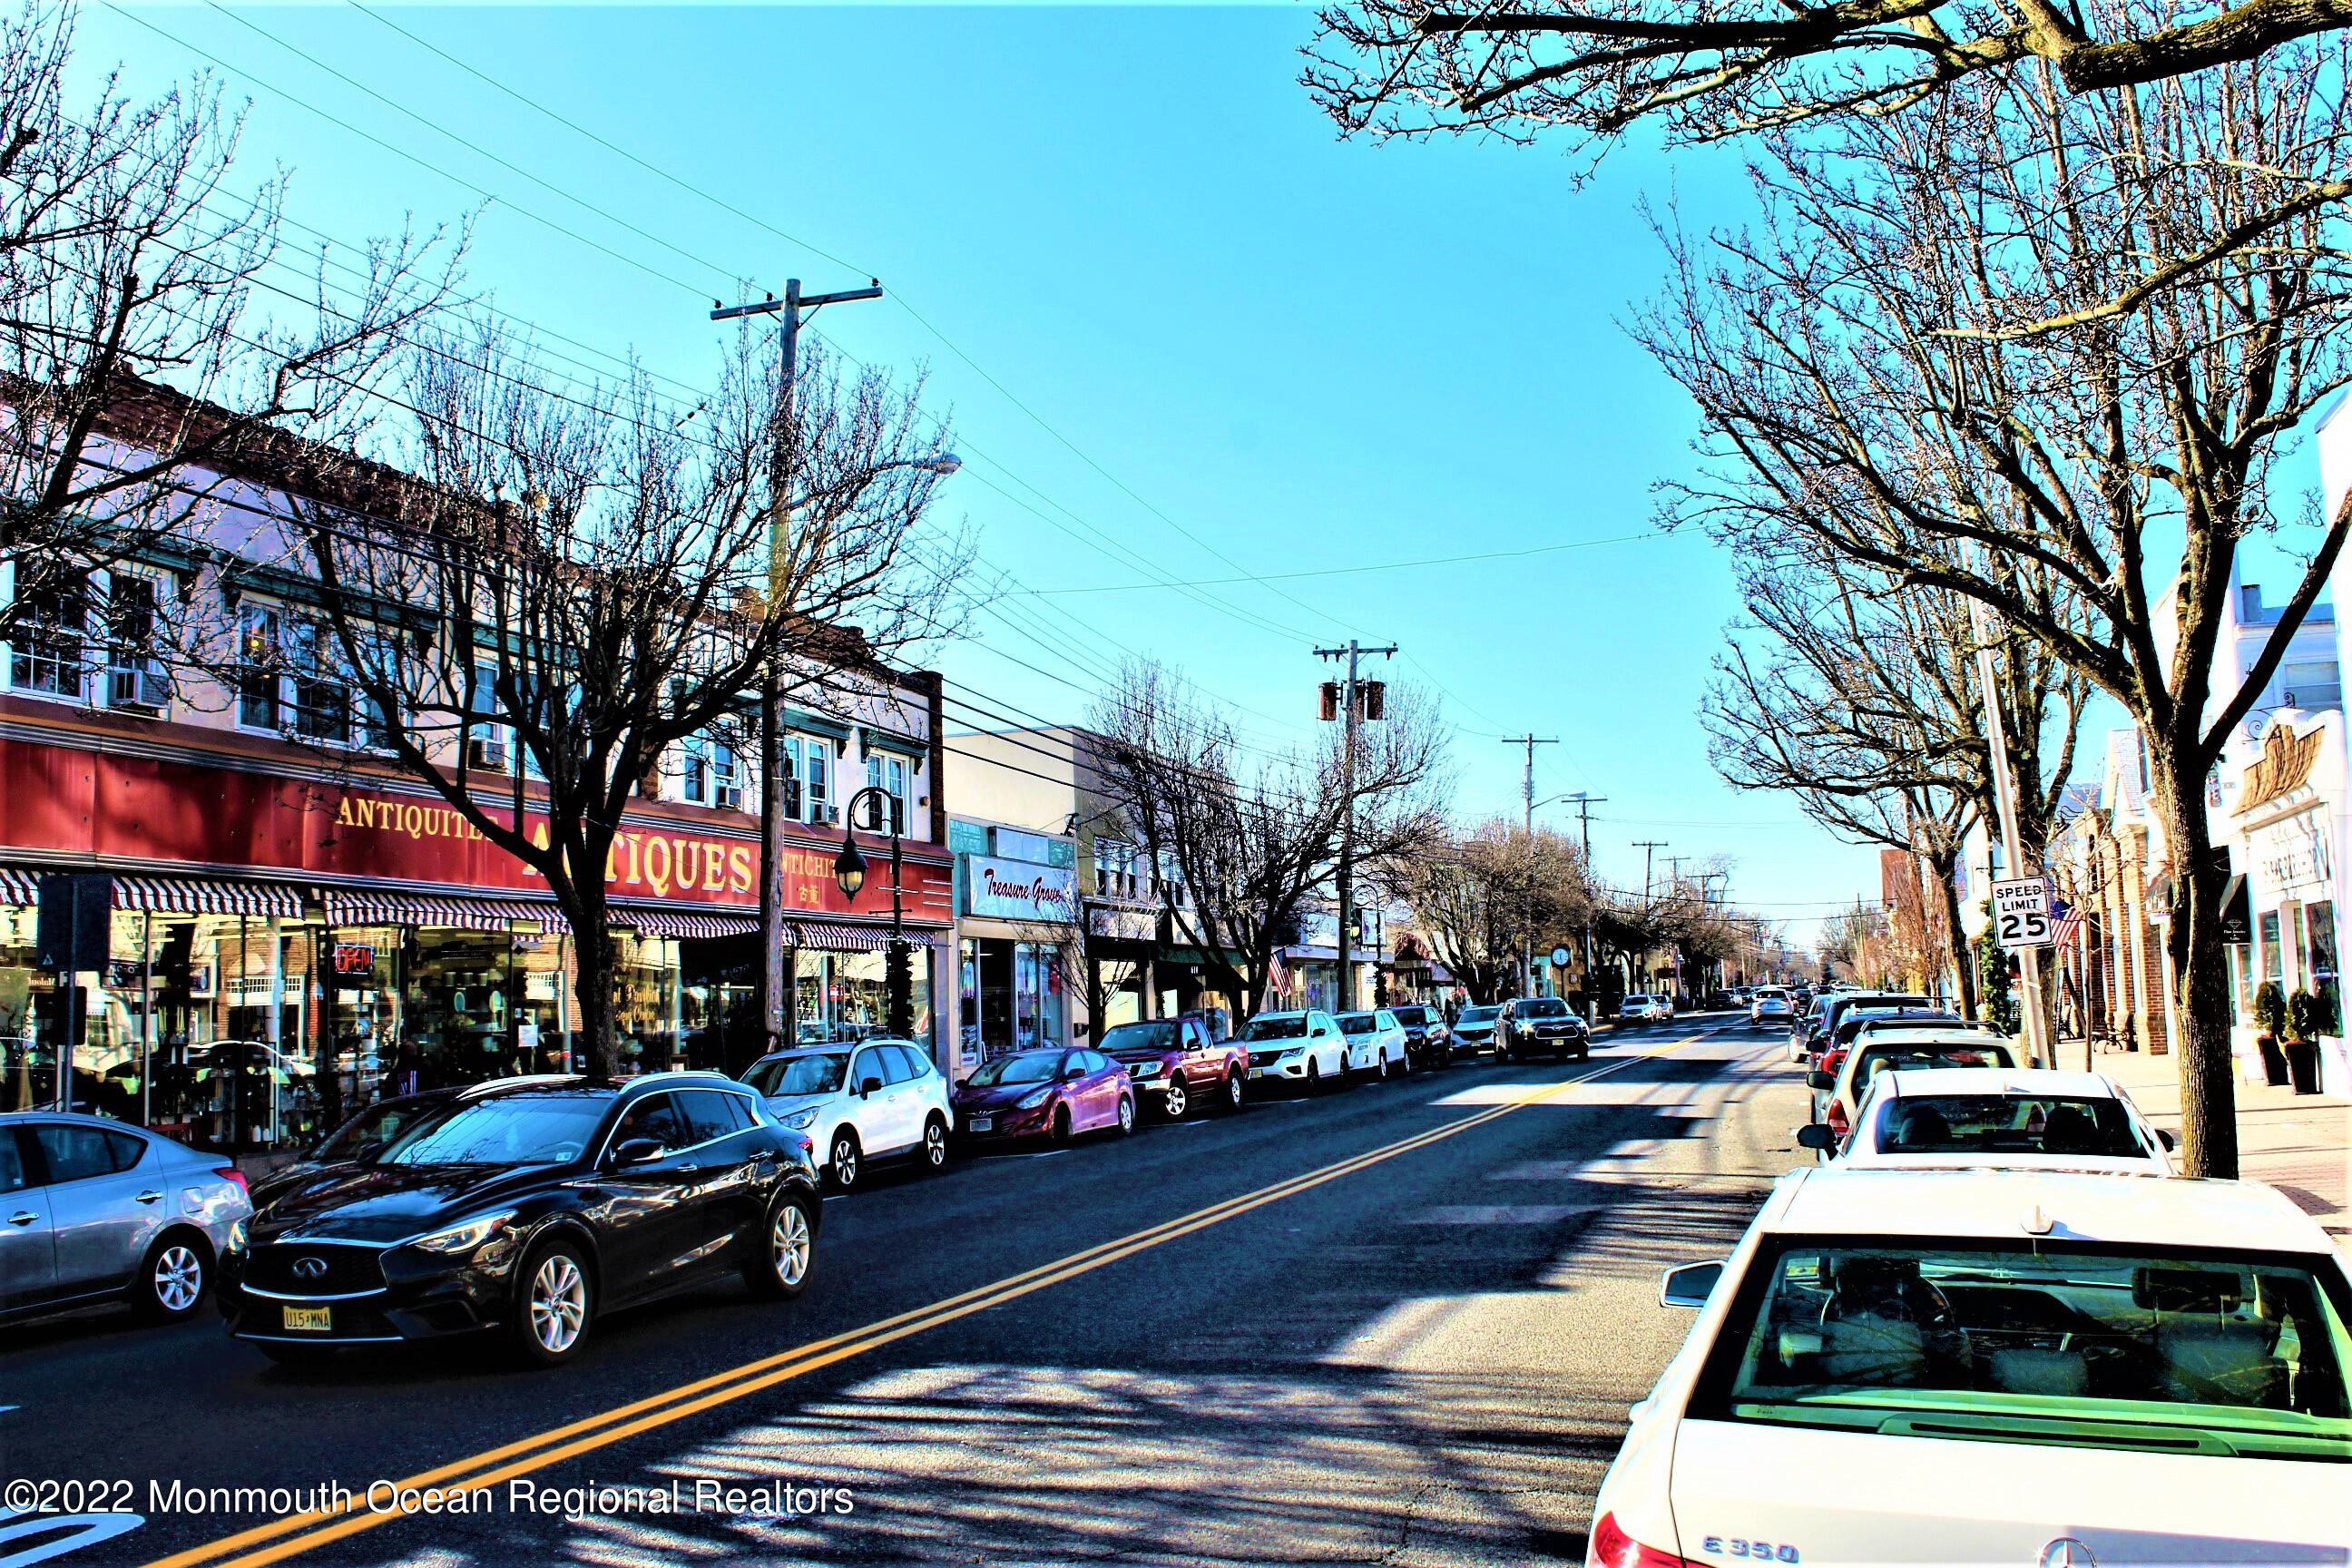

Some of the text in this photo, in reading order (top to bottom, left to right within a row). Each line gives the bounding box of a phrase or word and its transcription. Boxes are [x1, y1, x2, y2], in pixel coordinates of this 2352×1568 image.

[335, 797, 498, 841] ANTIQUITE
[523, 822, 752, 897] ATIQUES
[985, 868, 1029, 900] Treasure
[1996, 886, 2042, 899] SPEED
[2002, 899, 2038, 912] LIMIT
[2000, 913, 2046, 939] 25
[336, 946, 370, 972] OPEN
